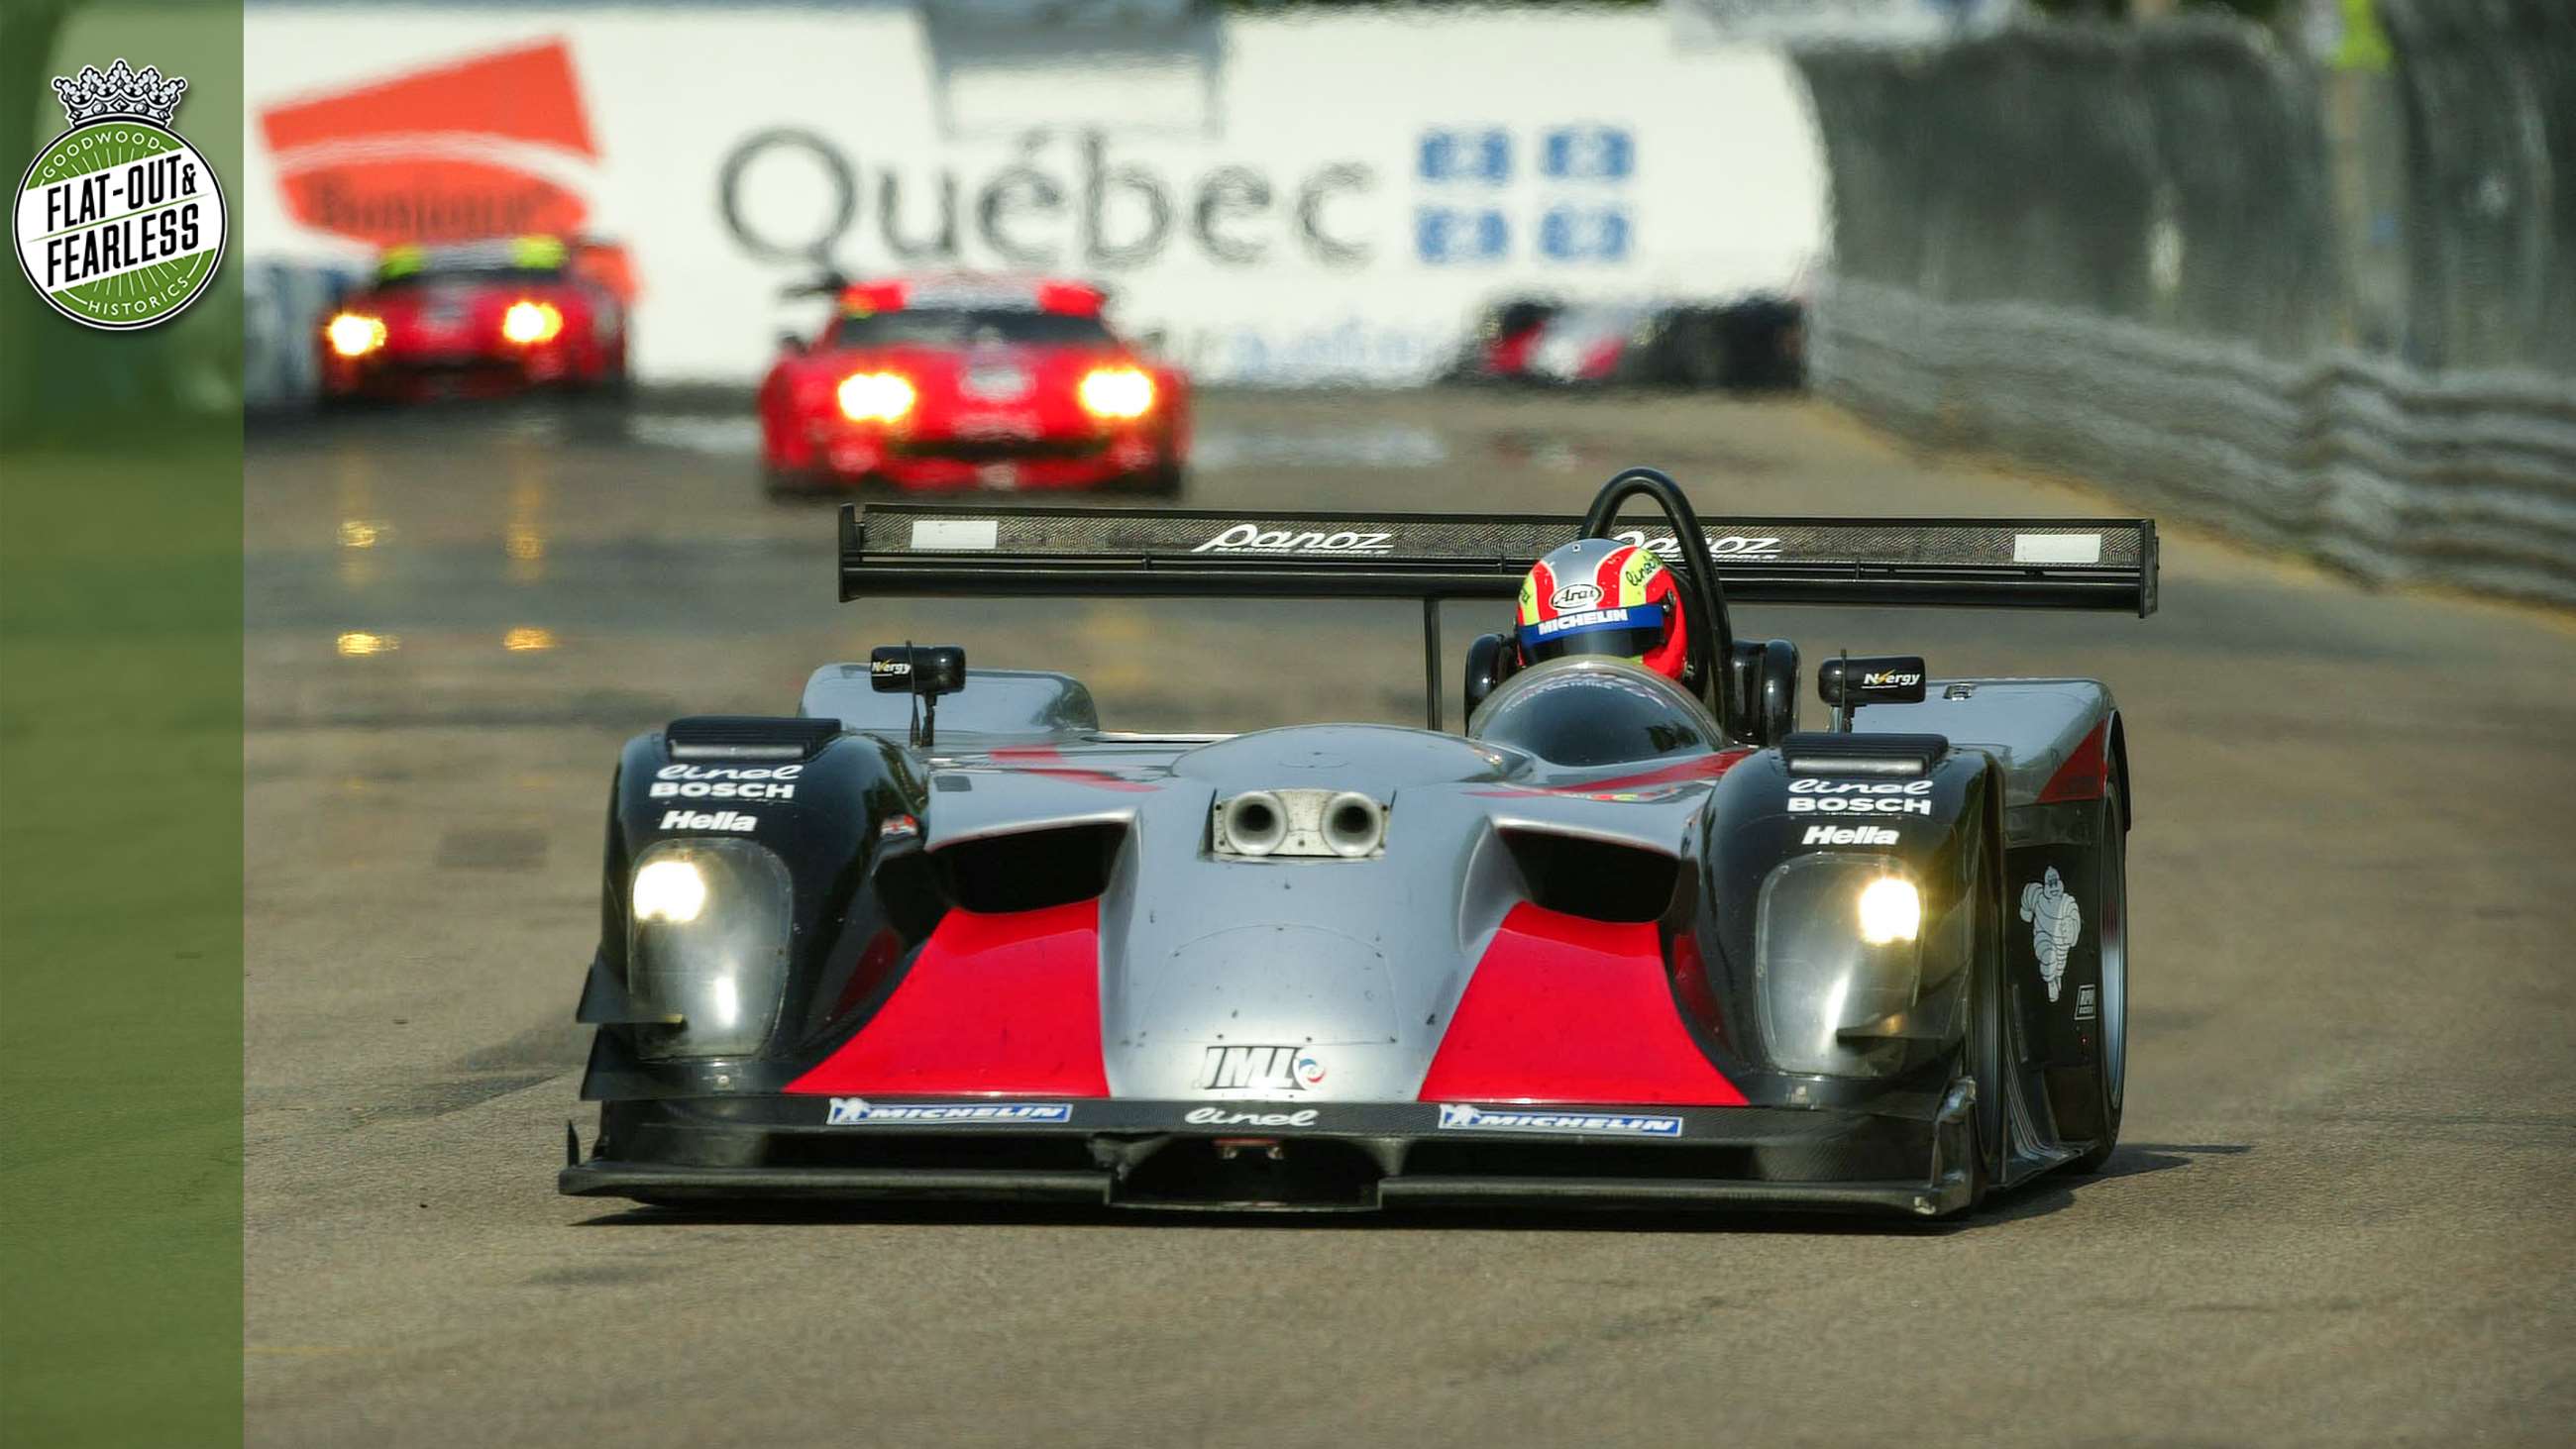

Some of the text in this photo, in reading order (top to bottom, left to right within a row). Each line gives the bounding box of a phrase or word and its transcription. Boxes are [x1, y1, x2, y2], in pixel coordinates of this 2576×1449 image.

[718, 126, 1377, 277] Québec
[1191, 523, 1394, 553] Panoz
[1538, 608, 1629, 635] MICHELIN
[649, 781, 795, 799] BOSCH
[1786, 796, 1932, 816] BOSCH
[659, 810, 759, 832] Hella
[1801, 825, 1900, 845] Hella
[868, 1107, 1063, 1119] MICHELIN
[1185, 1106, 1319, 1126] linel
[1479, 1115, 1674, 1131] MICHELIN
